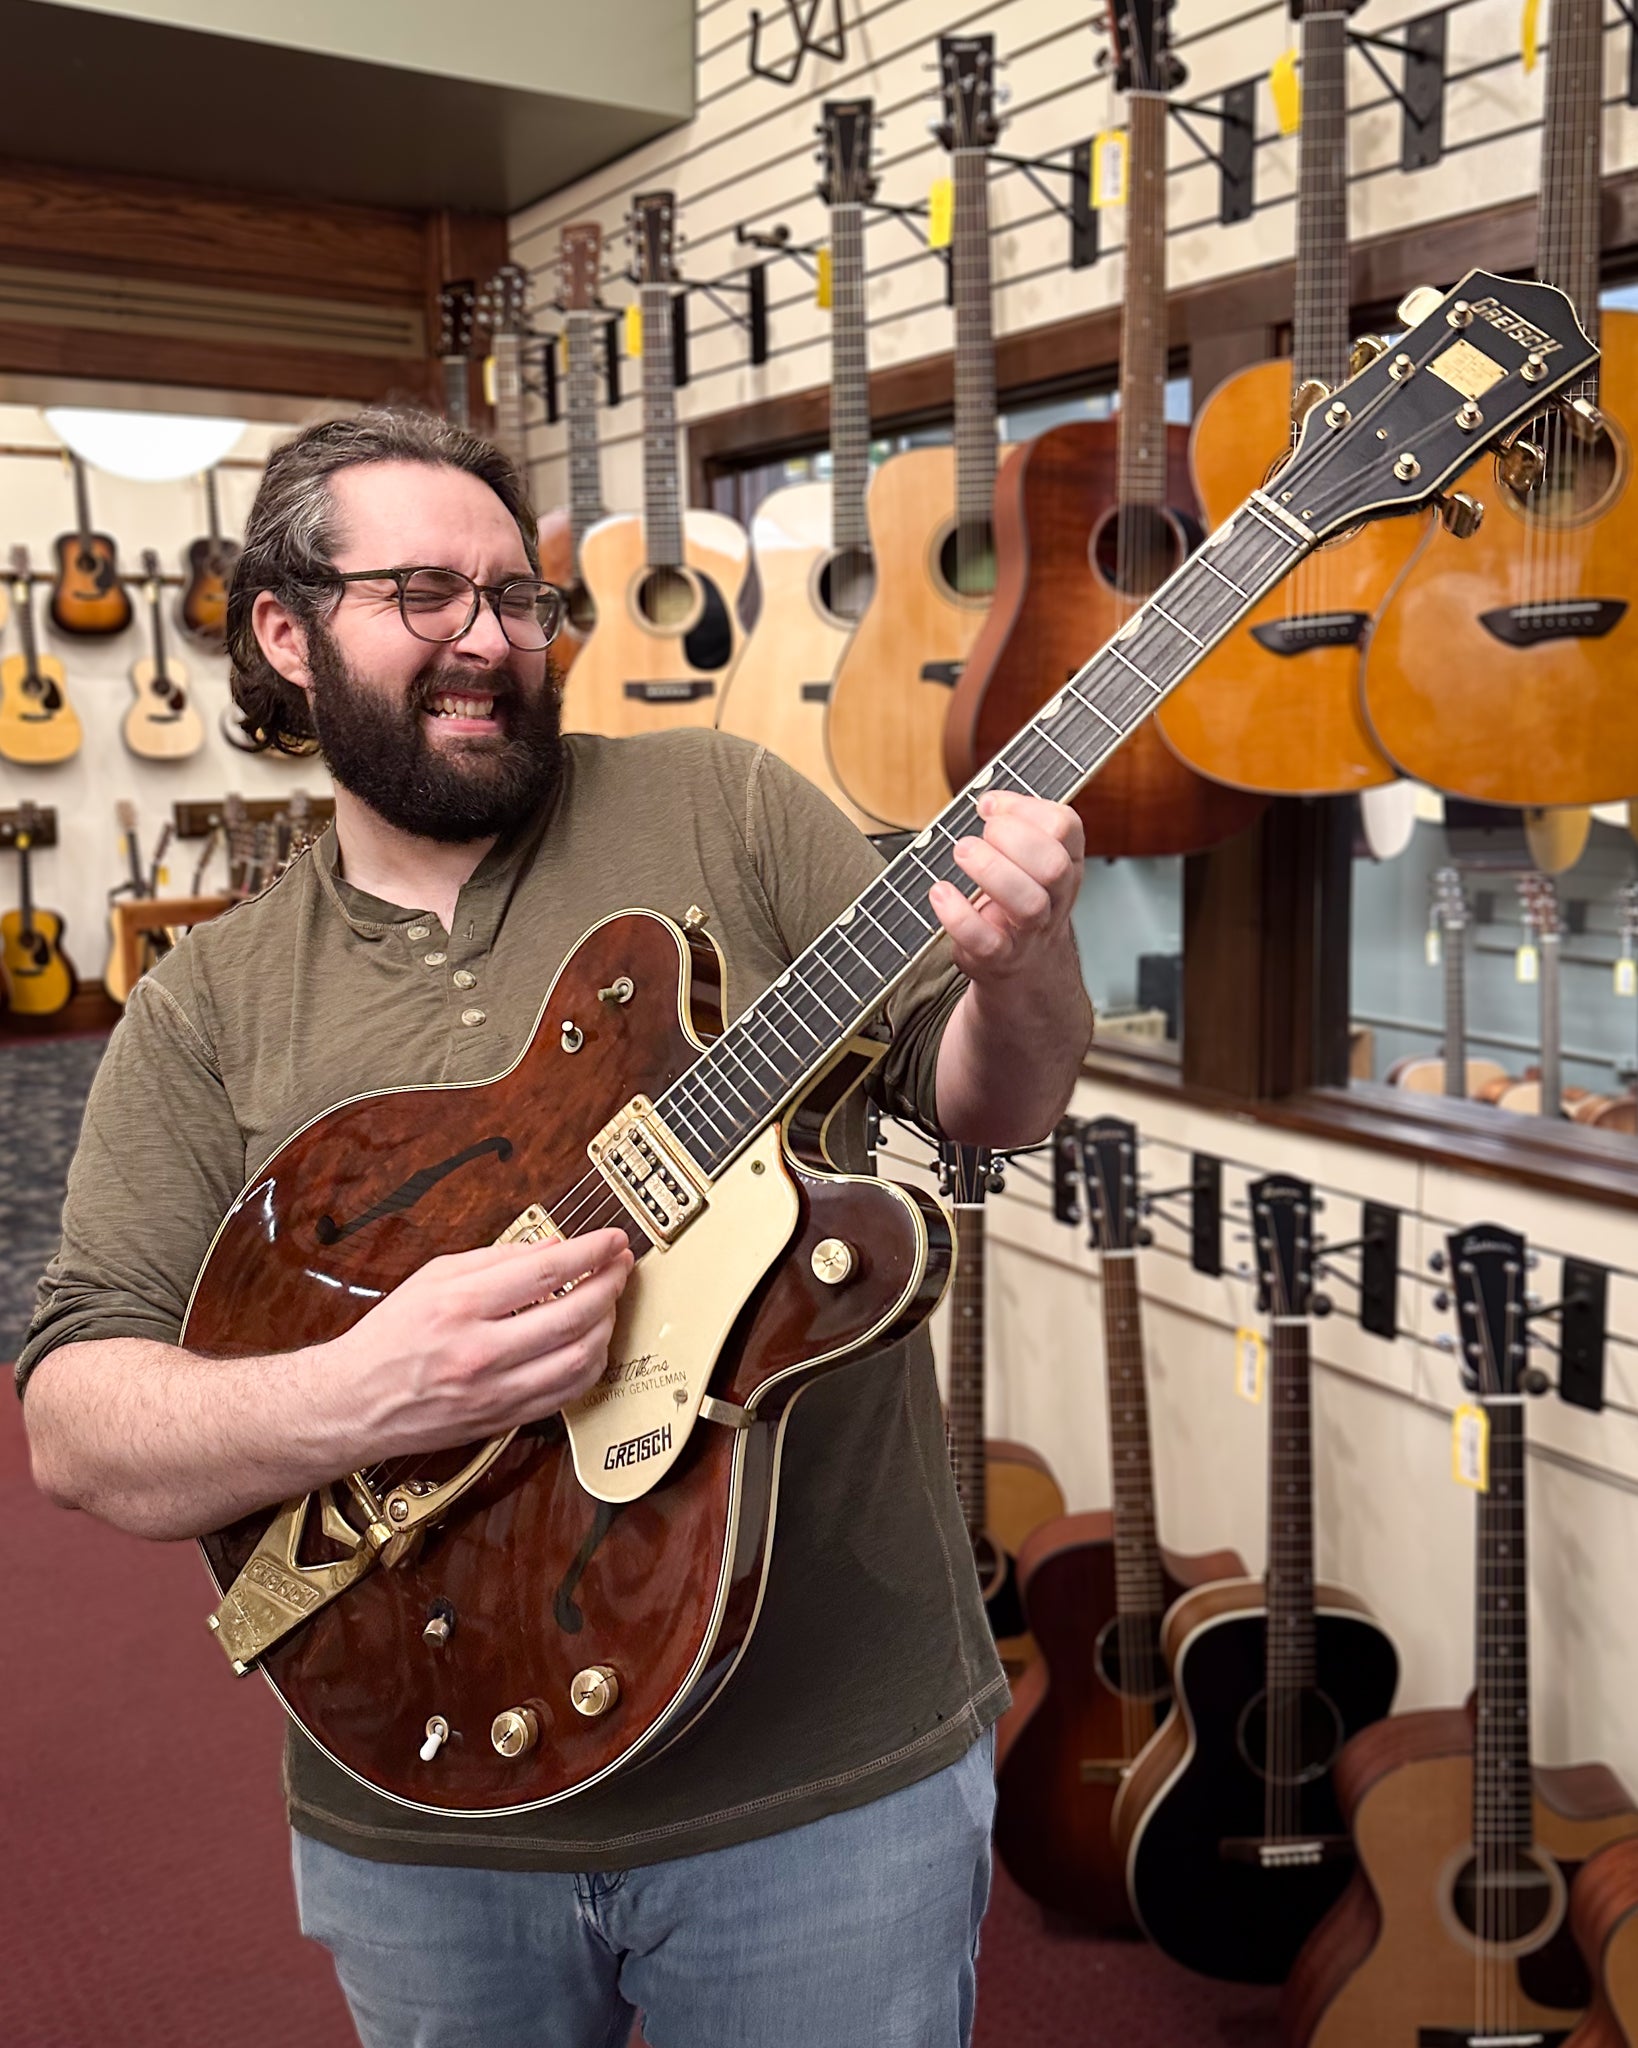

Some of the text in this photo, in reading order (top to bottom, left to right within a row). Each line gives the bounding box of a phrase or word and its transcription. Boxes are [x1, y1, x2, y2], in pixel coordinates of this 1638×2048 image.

[1470, 296, 1564, 355] GRETSCH
[624, 1353, 670, 1382] Atkins
[629, 1370, 687, 1395] GENTLEMAN
[603, 1422, 672, 1470] GRETSCH
